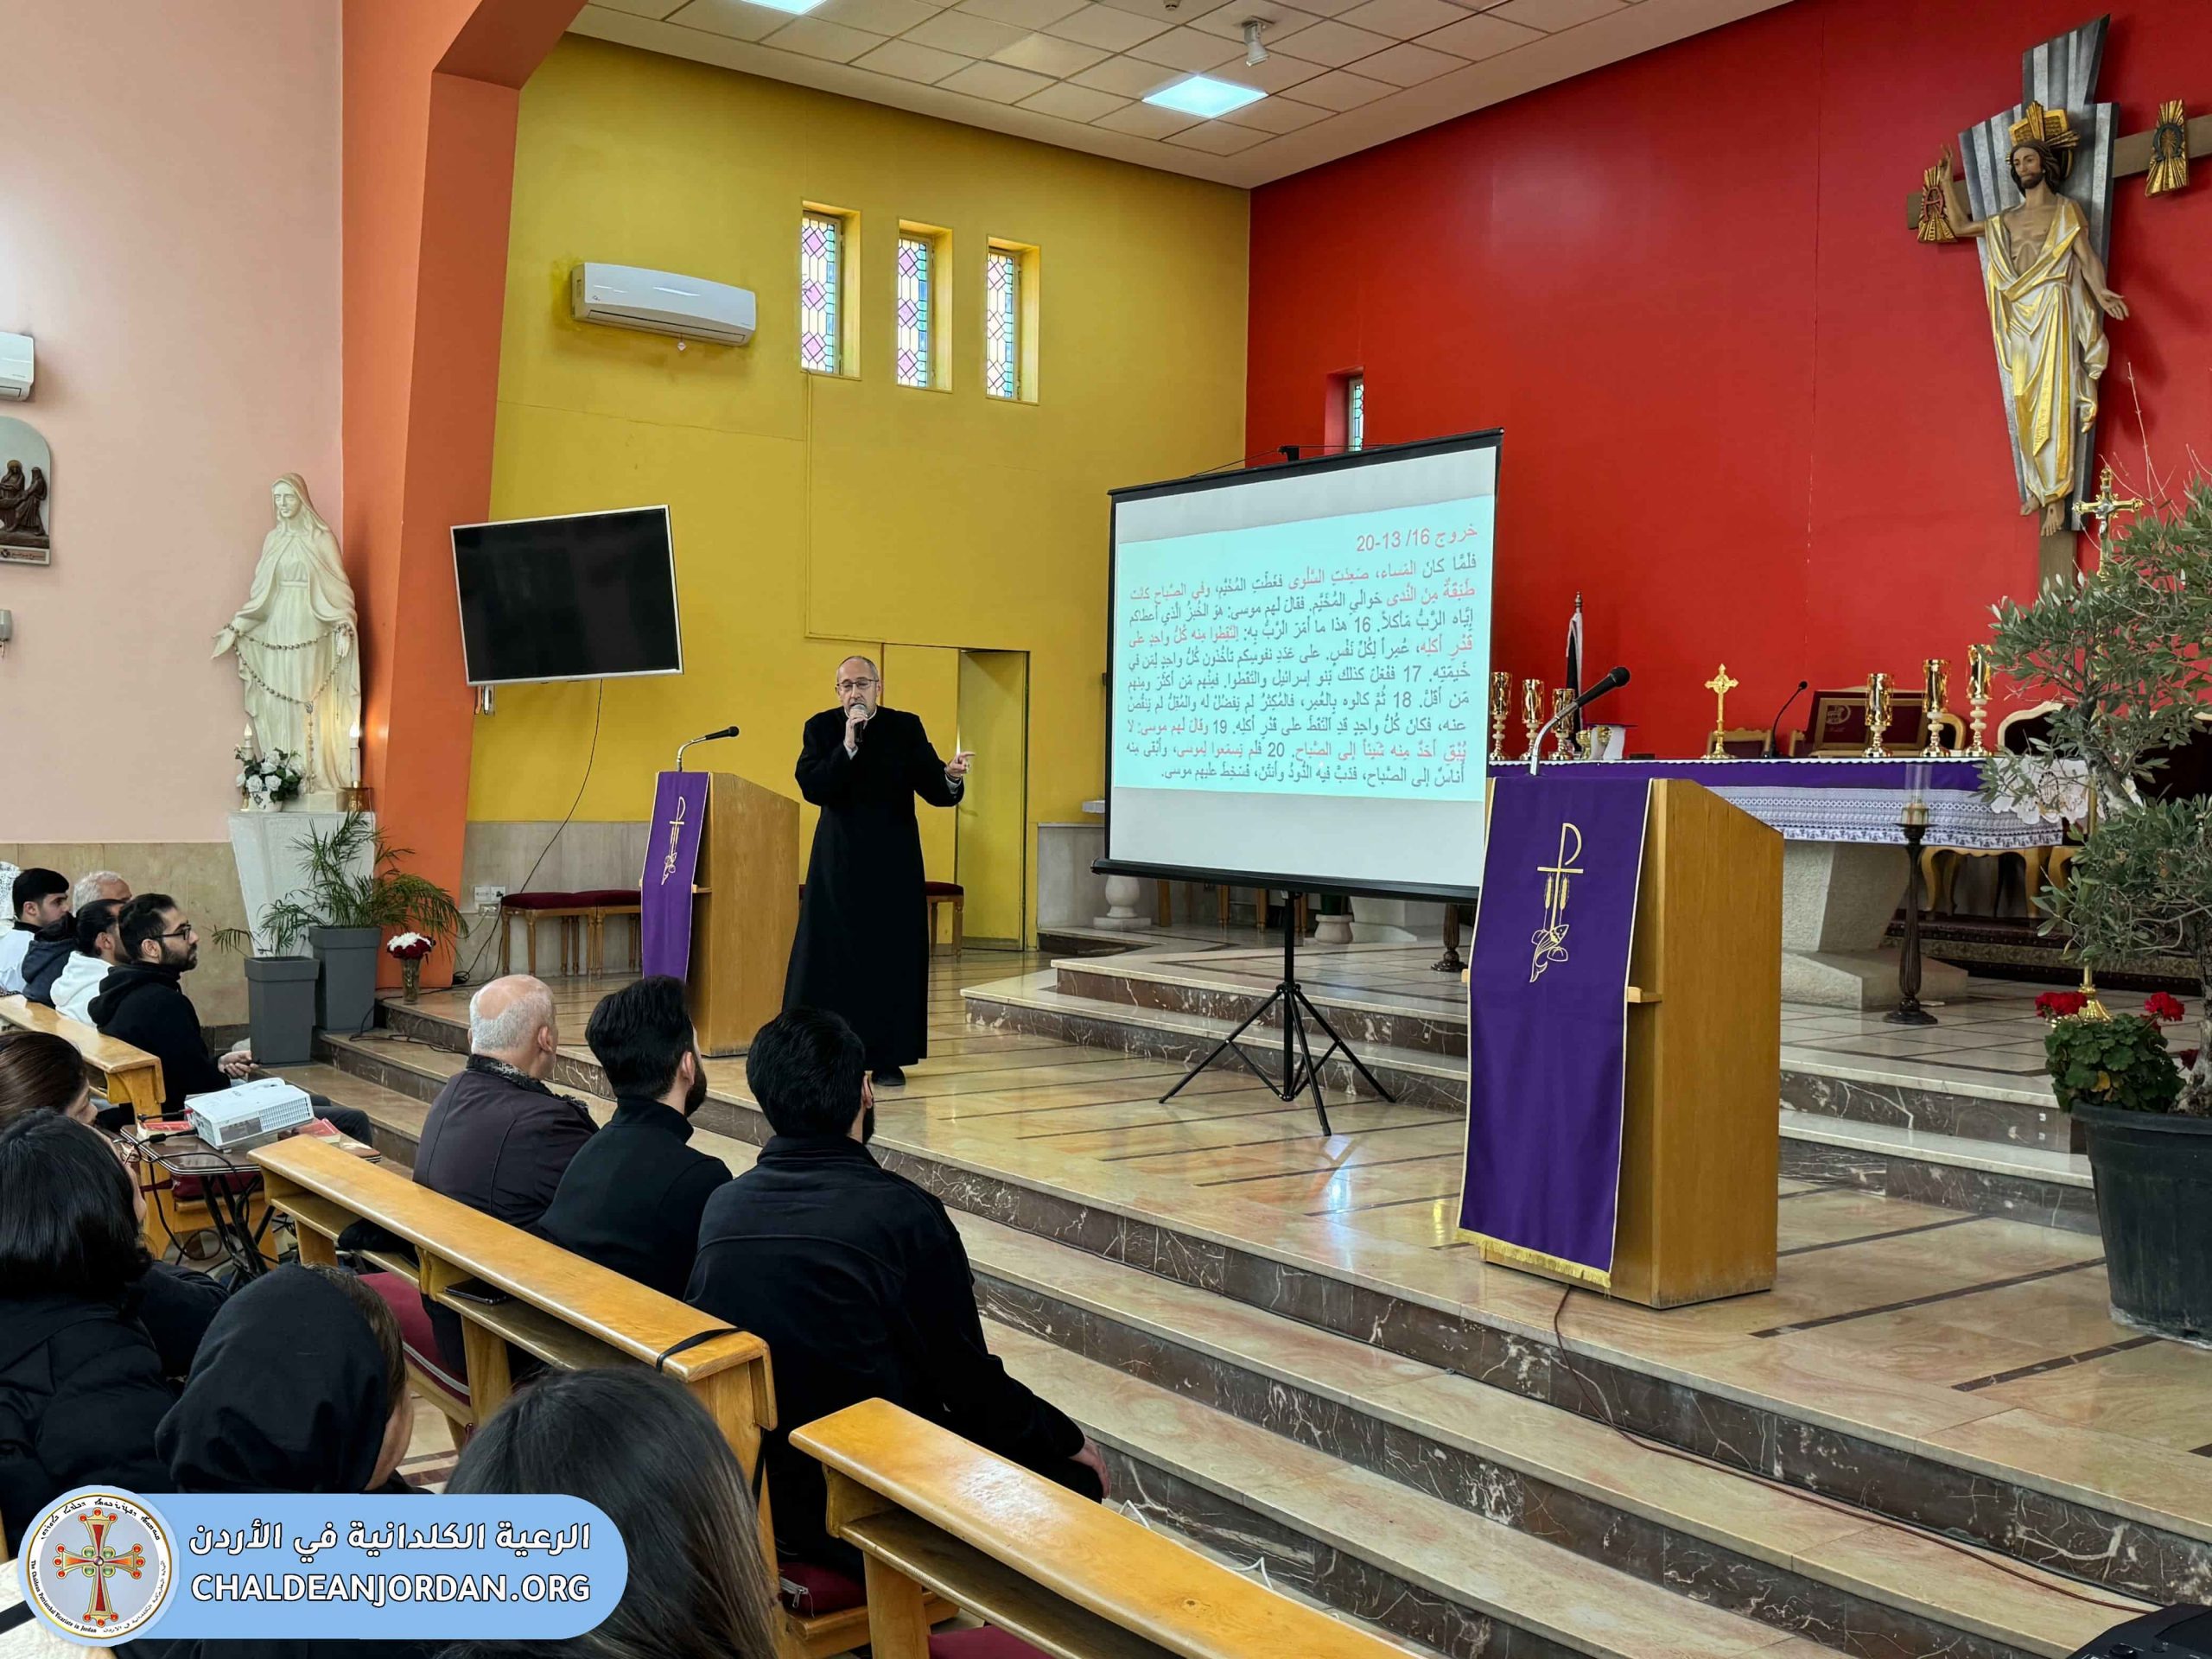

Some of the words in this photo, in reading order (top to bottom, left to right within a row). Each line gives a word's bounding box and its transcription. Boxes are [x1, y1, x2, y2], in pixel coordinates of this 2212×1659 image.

[1314, 619, 1325, 632] ما
[1354, 615, 1370, 633] 16
[1402, 664, 1421, 683] 17
[1392, 690, 1412, 709] 18
[1212, 718, 1227, 734] 19
[1267, 741, 1285, 758] 20
